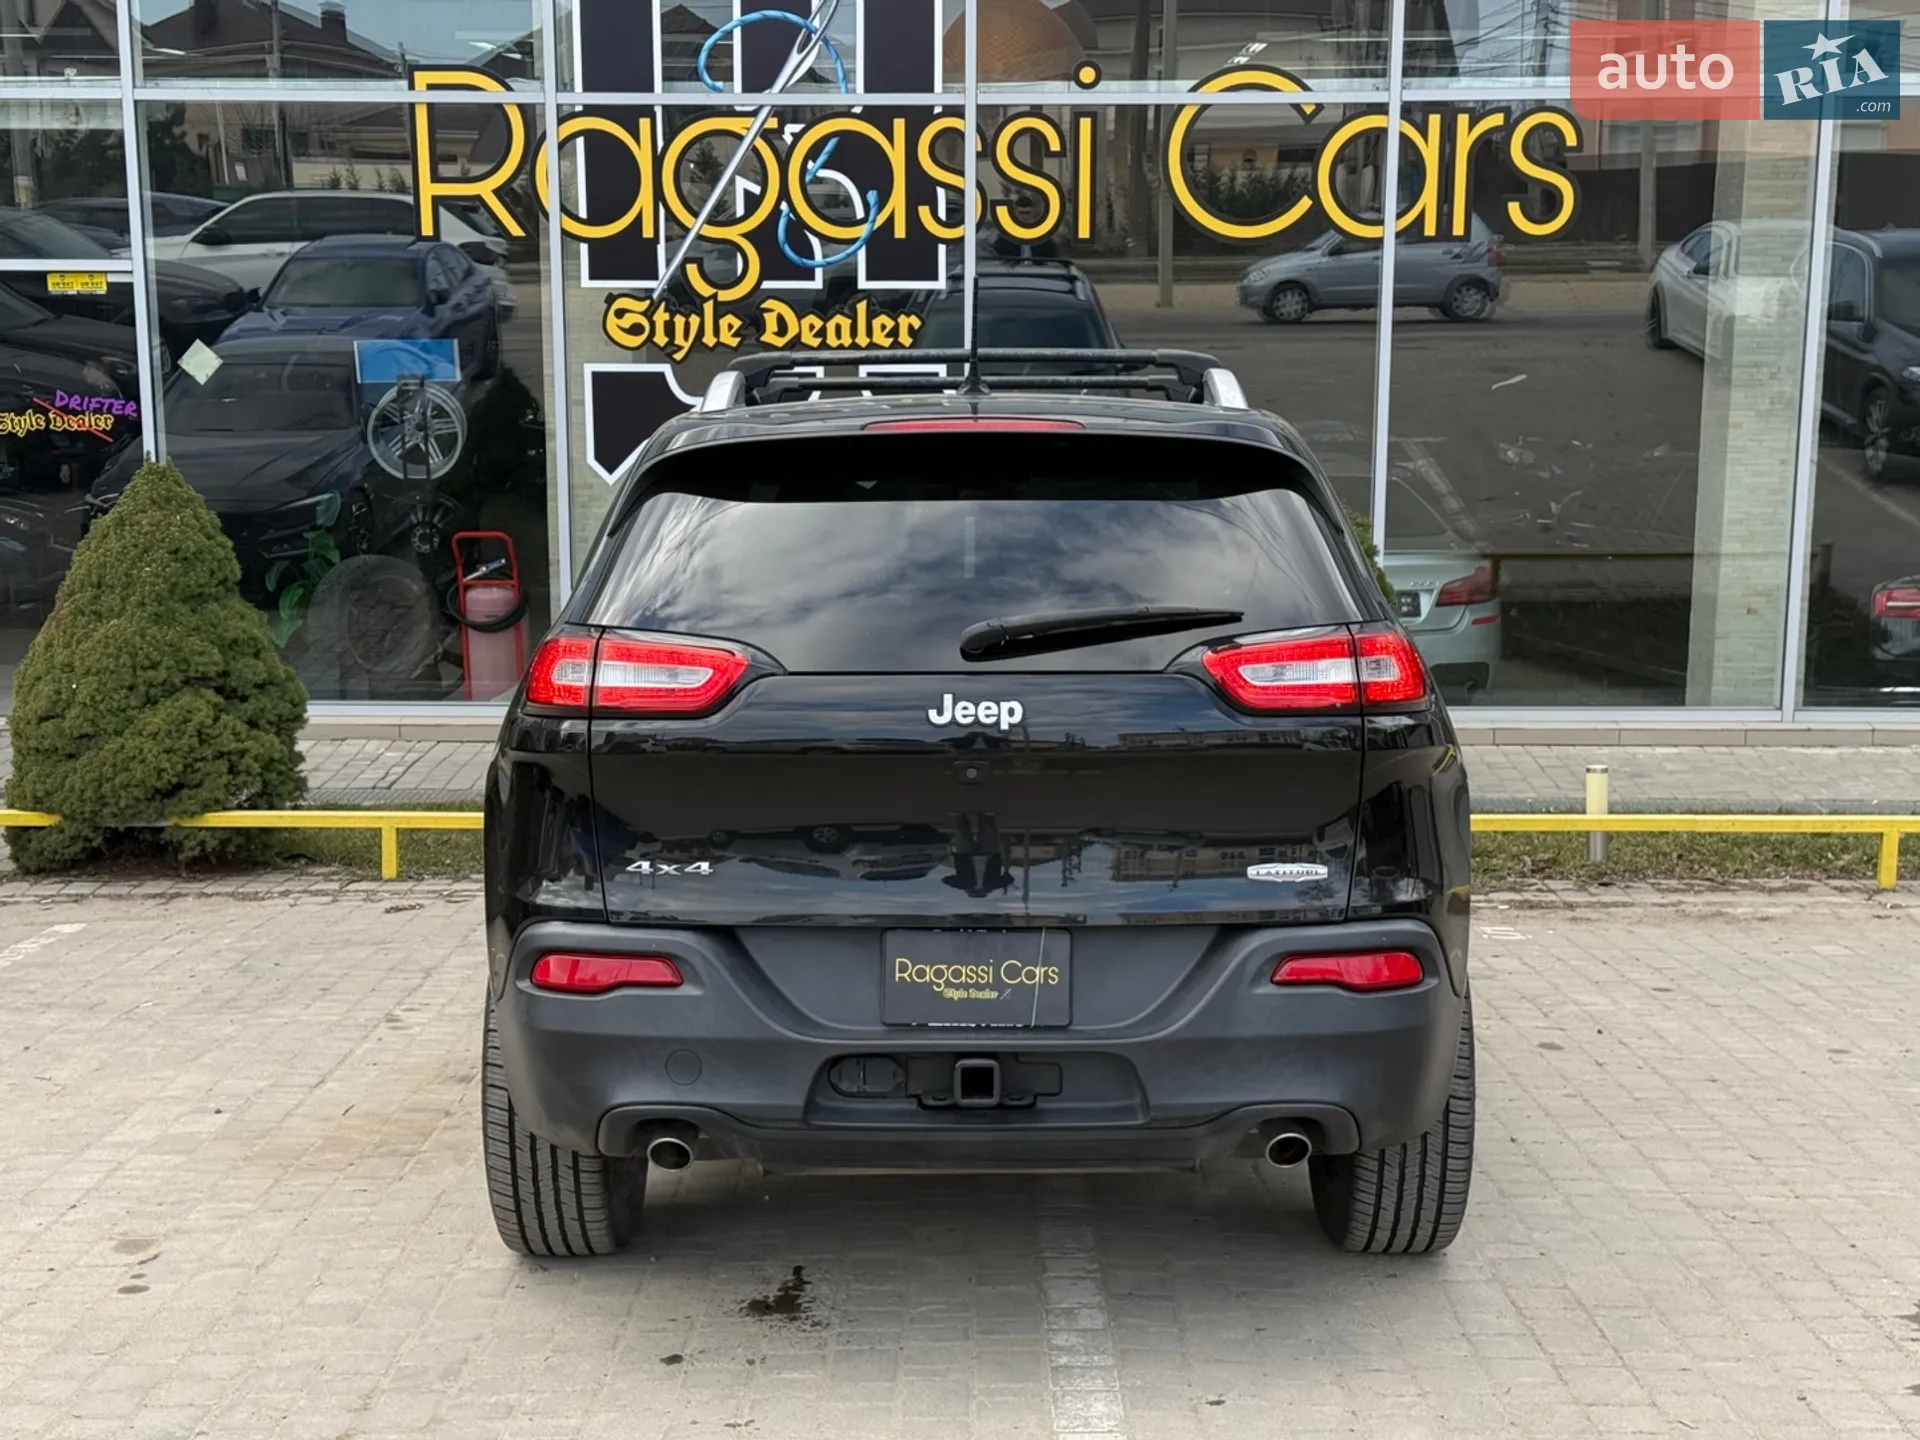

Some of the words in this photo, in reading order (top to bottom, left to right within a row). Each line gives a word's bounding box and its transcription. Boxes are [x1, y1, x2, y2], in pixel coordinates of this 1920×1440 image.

[414, 69, 1093, 303] Ragassi
[1168, 70, 1578, 238] Cars
[605, 296, 743, 362] Style
[759, 297, 923, 349] Dealer
[55, 389, 137, 417] DRIFTER
[0, 408, 46, 438] Style
[48, 409, 115, 432] Dealer
[928, 693, 1024, 731] Jeep
[625, 860, 714, 876] 4x4
[894, 957, 994, 992] Ragassi
[1000, 959, 1059, 985] Cars
